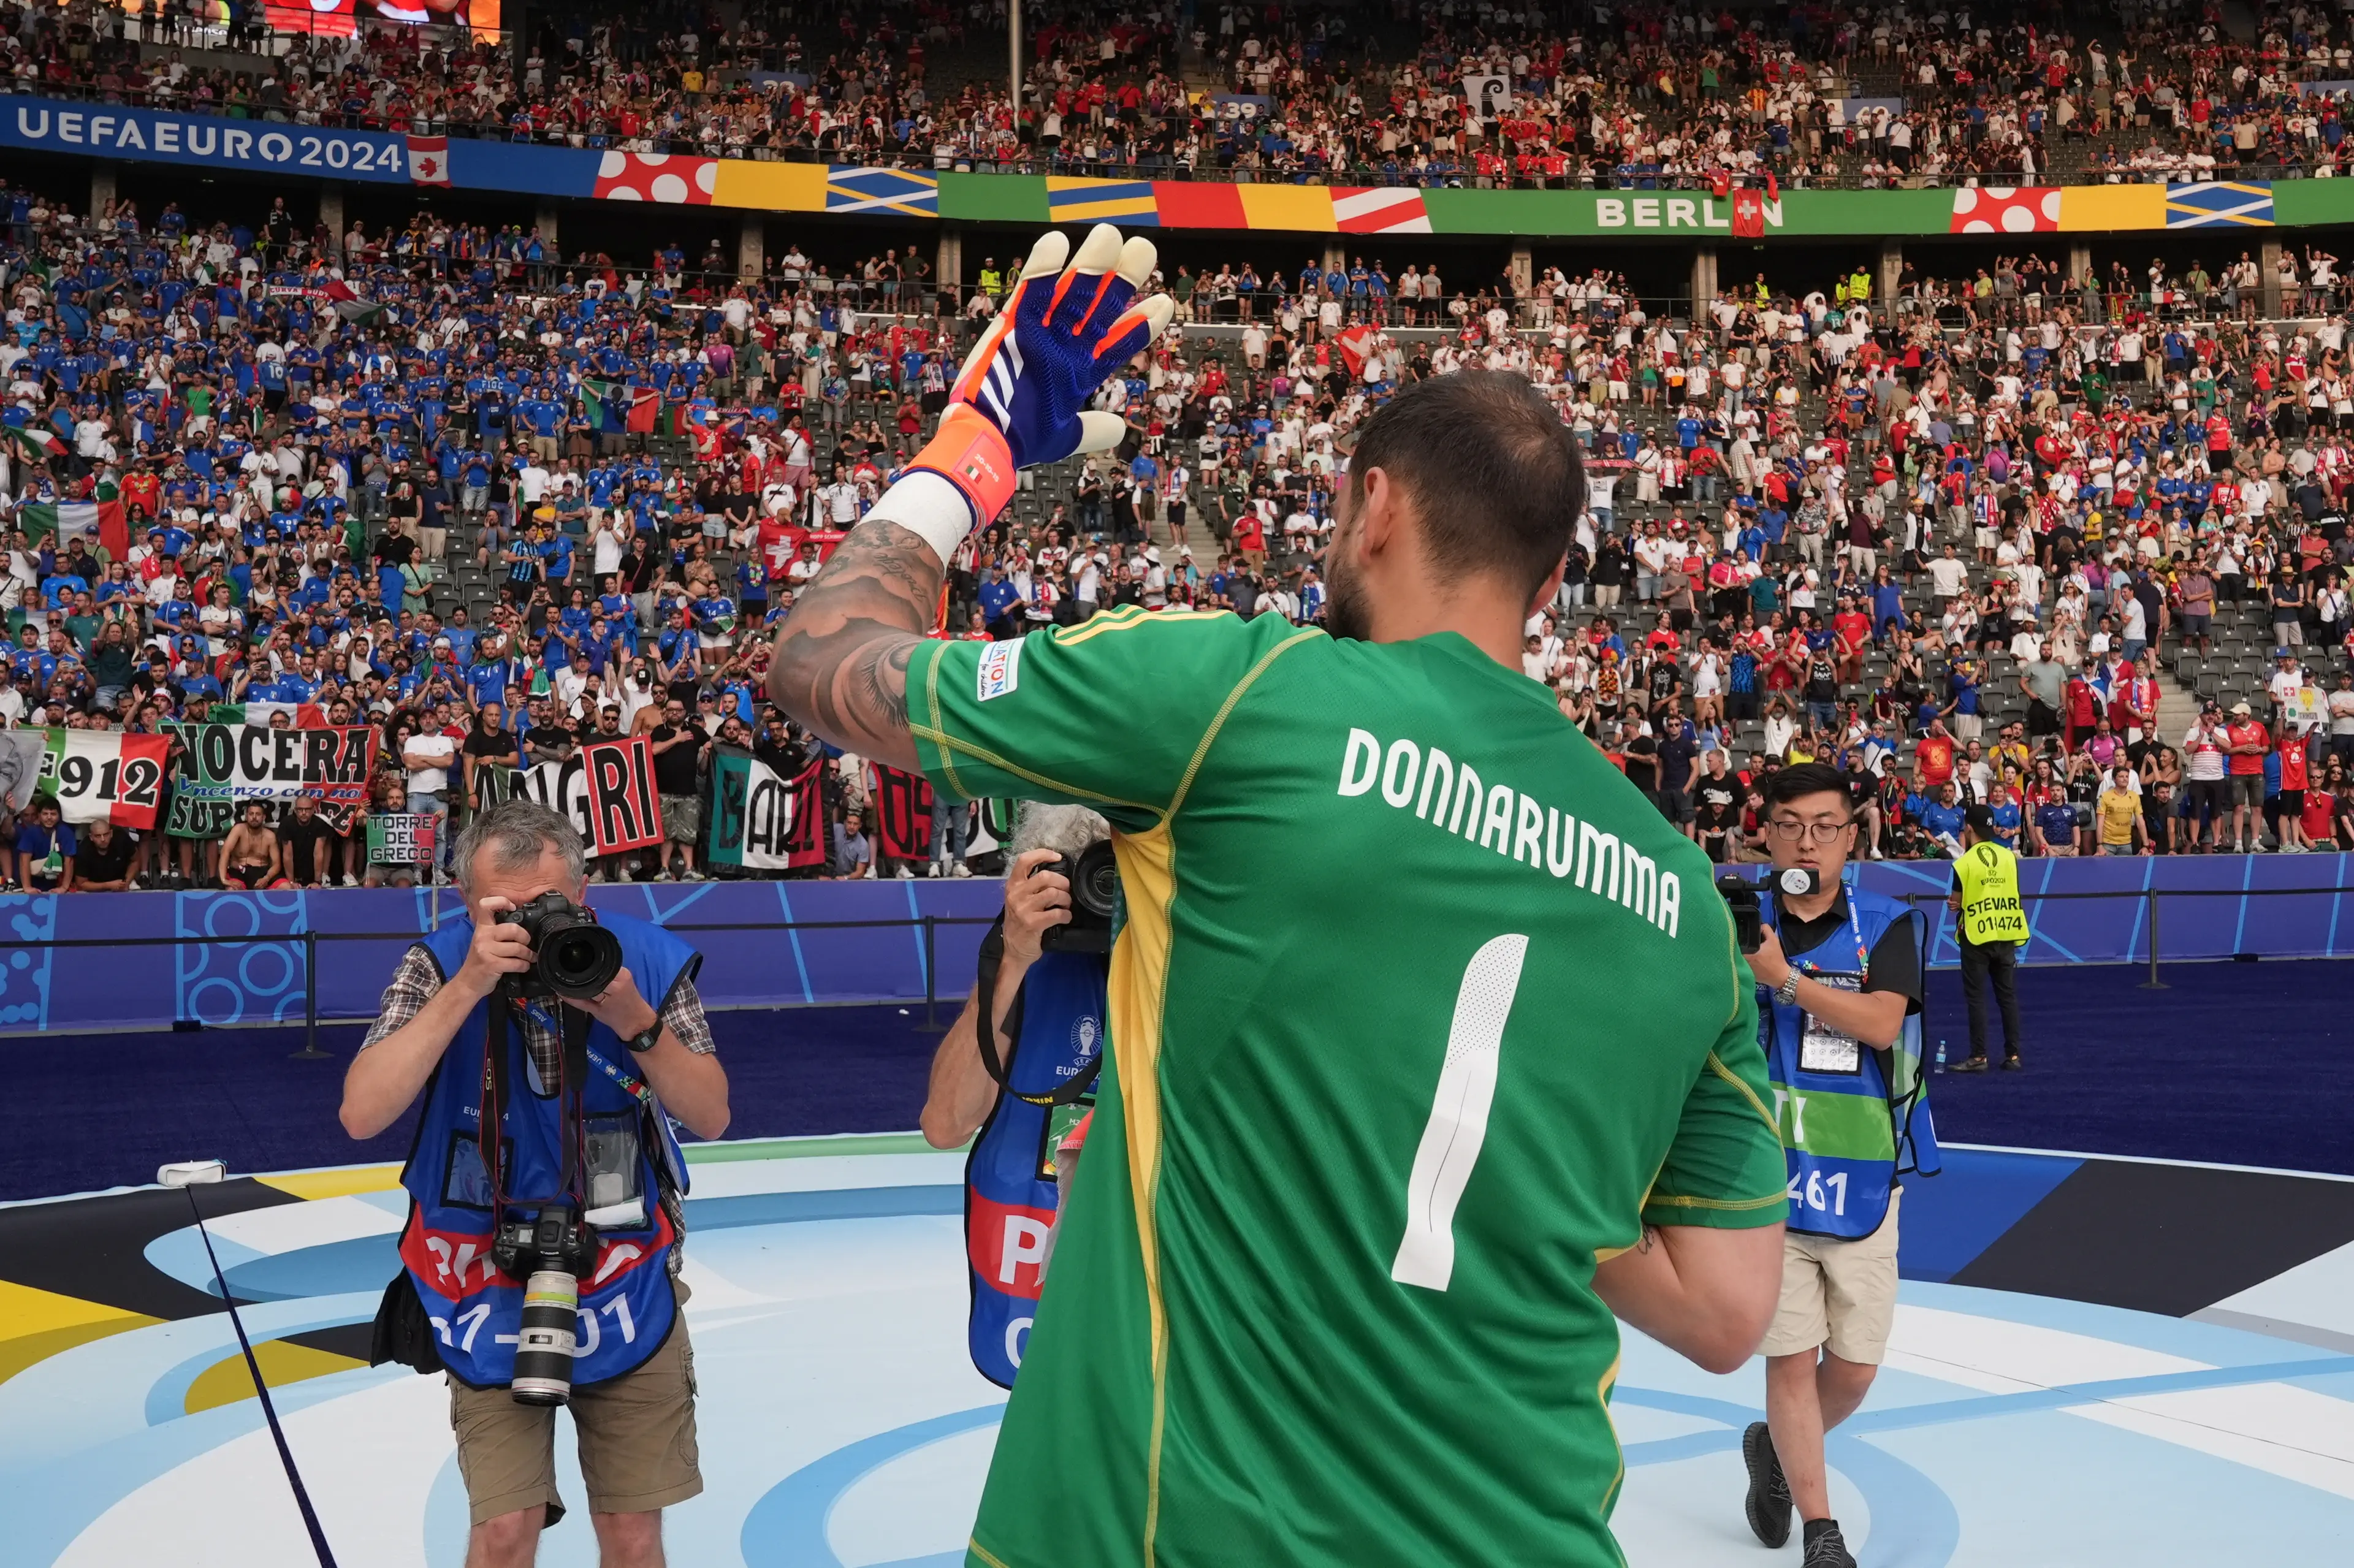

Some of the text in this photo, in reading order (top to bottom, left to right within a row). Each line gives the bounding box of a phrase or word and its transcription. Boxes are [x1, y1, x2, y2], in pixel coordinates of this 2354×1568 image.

[1225, 102, 1257, 119] 39
[18, 108, 147, 150] UEFA
[300, 137, 402, 172] 2024
[1596, 199, 1783, 227] BERLN
[269, 363, 283, 378] 10
[160, 725, 370, 784] NOCERA
[180, 777, 274, 797] Vncenzo
[281, 787, 326, 798] con
[370, 816, 433, 829] TORRE
[719, 771, 815, 856] BARI
[384, 831, 419, 845] DEL
[1337, 728, 1682, 939] DONNARUMMA
[370, 847, 432, 861] GRECO
[1391, 934, 1529, 1292] 1
